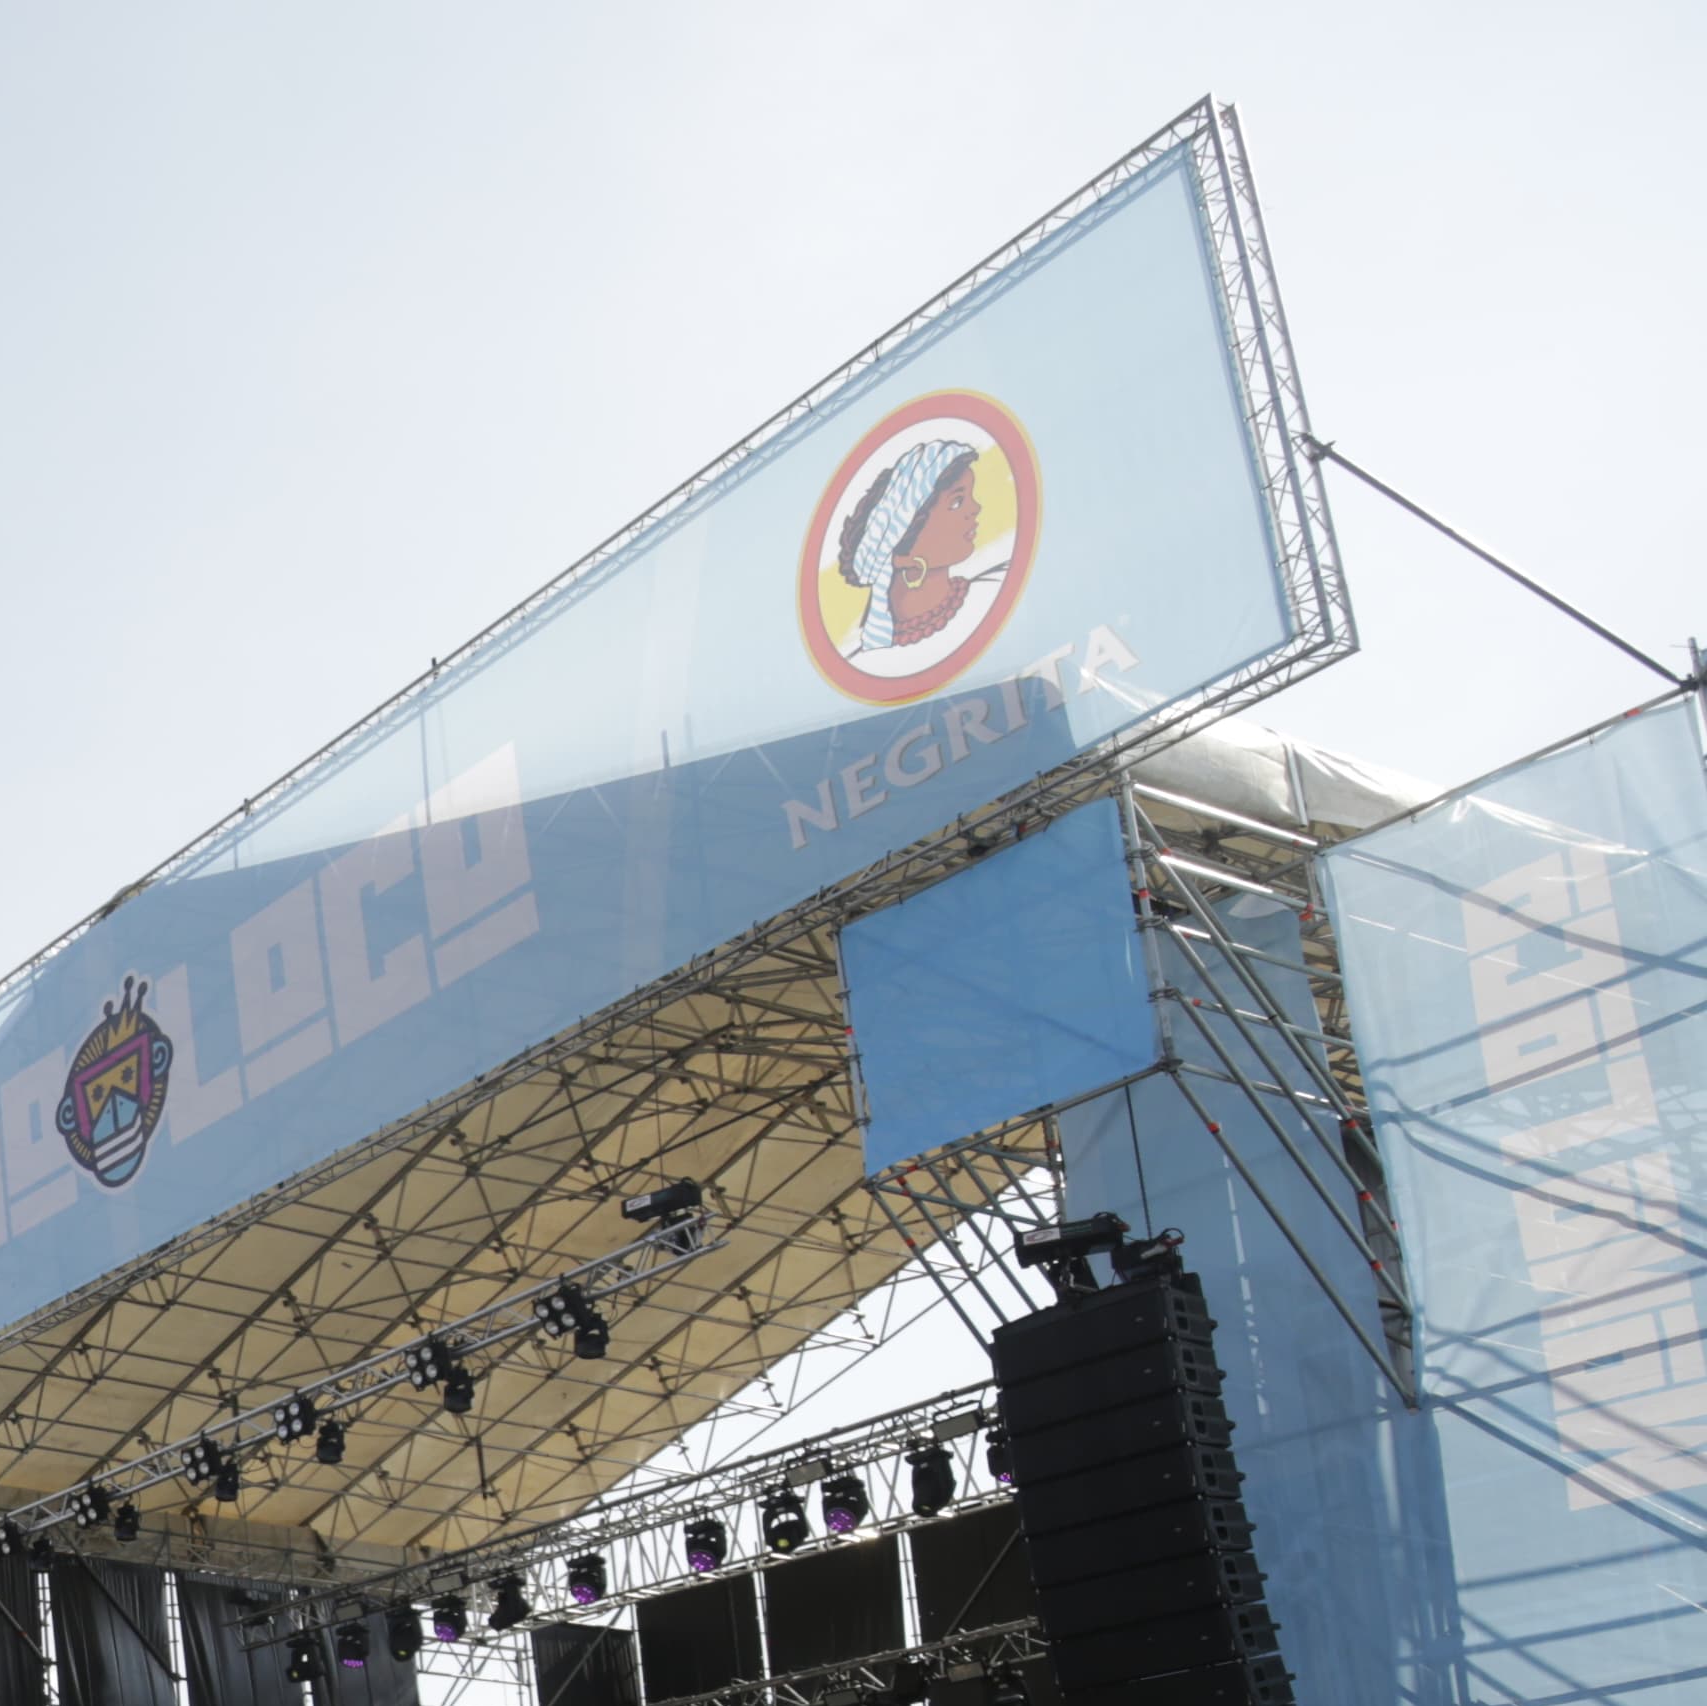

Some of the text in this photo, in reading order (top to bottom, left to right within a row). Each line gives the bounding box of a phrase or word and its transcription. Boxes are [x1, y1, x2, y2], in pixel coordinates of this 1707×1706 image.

[779, 623, 1142, 851] NEGRITA
[155, 739, 541, 1148] LOCO
[1459, 844, 1660, 1168] LOCO
